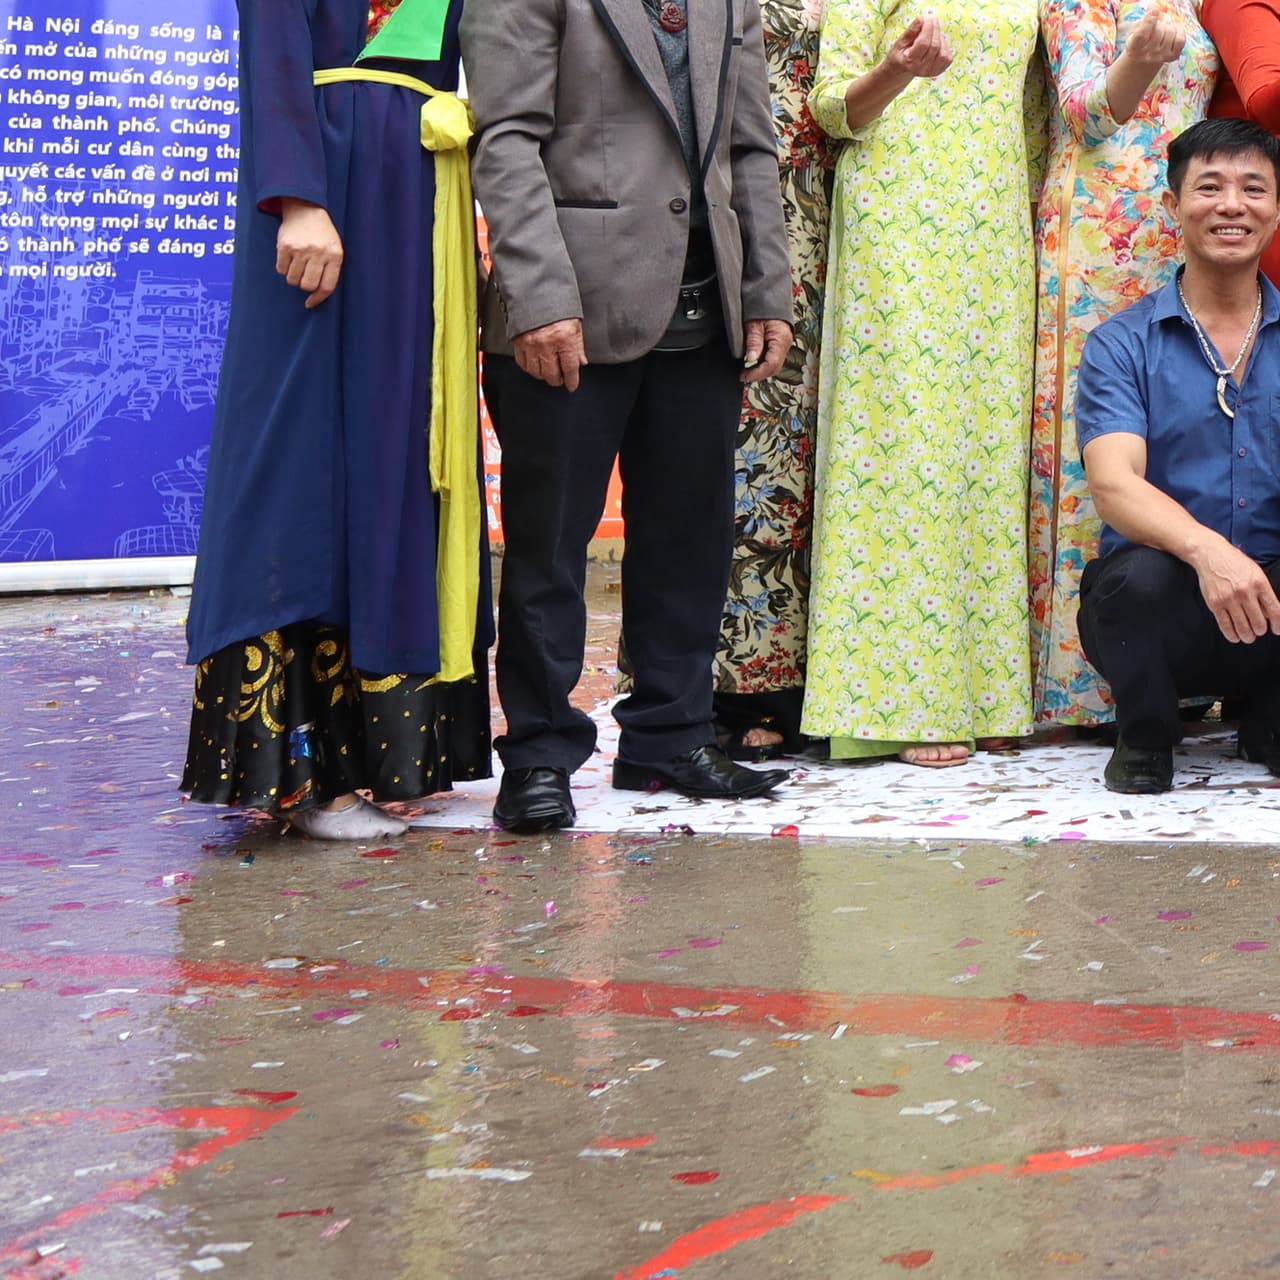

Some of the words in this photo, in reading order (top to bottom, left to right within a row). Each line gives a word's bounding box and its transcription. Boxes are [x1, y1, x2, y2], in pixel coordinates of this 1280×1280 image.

[7, 16, 34, 31] Hà
[46, 17, 80, 36] Nội
[91, 19, 139, 40] đáng
[150, 22, 195, 42] sống
[206, 25, 222, 40] là
[25, 41, 58, 56] mở
[64, 41, 98, 58] của
[105, 44, 167, 65] những
[174, 48, 229, 66] người
[27, 68, 84, 85] mong
[89, 67, 144, 84] muốn
[150, 70, 199, 90] đóng
[204, 72, 239, 92] góp
[8, 88, 70, 109] không
[76, 91, 122, 109] gian,
[128, 93, 164, 108] môi
[170, 95, 239, 115] trường,
[8, 113, 42, 129] của
[52, 114, 109, 131] thành
[118, 117, 160, 135] phố.
[170, 118, 231, 138] Chúng
[4, 137, 34, 153] khi
[42, 136, 79, 154] mỗi
[87, 142, 112, 155] cư
[119, 140, 154, 156] dân
[162, 141, 208, 162] cùng
[54, 163, 86, 179] các
[91, 163, 126, 179] vấn
[131, 164, 155, 180] đề
[161, 165, 174, 181] ở
[179, 167, 209, 182] nơi
[22, 185, 47, 202] hỗ
[55, 189, 85, 206] trợ
[92, 188, 155, 209] những
[163, 191, 219, 209] người
[0, 212, 33, 227] tôn
[41, 214, 95, 231] trọng
[102, 213, 139, 231] mọi
[145, 216, 169, 232] sự
[174, 214, 218, 230] khác
[18, 236, 75, 252] thành
[84, 236, 123, 256] phố
[129, 238, 150, 253] sẽ
[158, 238, 206, 257] đáng
[9, 261, 47, 279] mọi
[54, 261, 117, 280] người.
